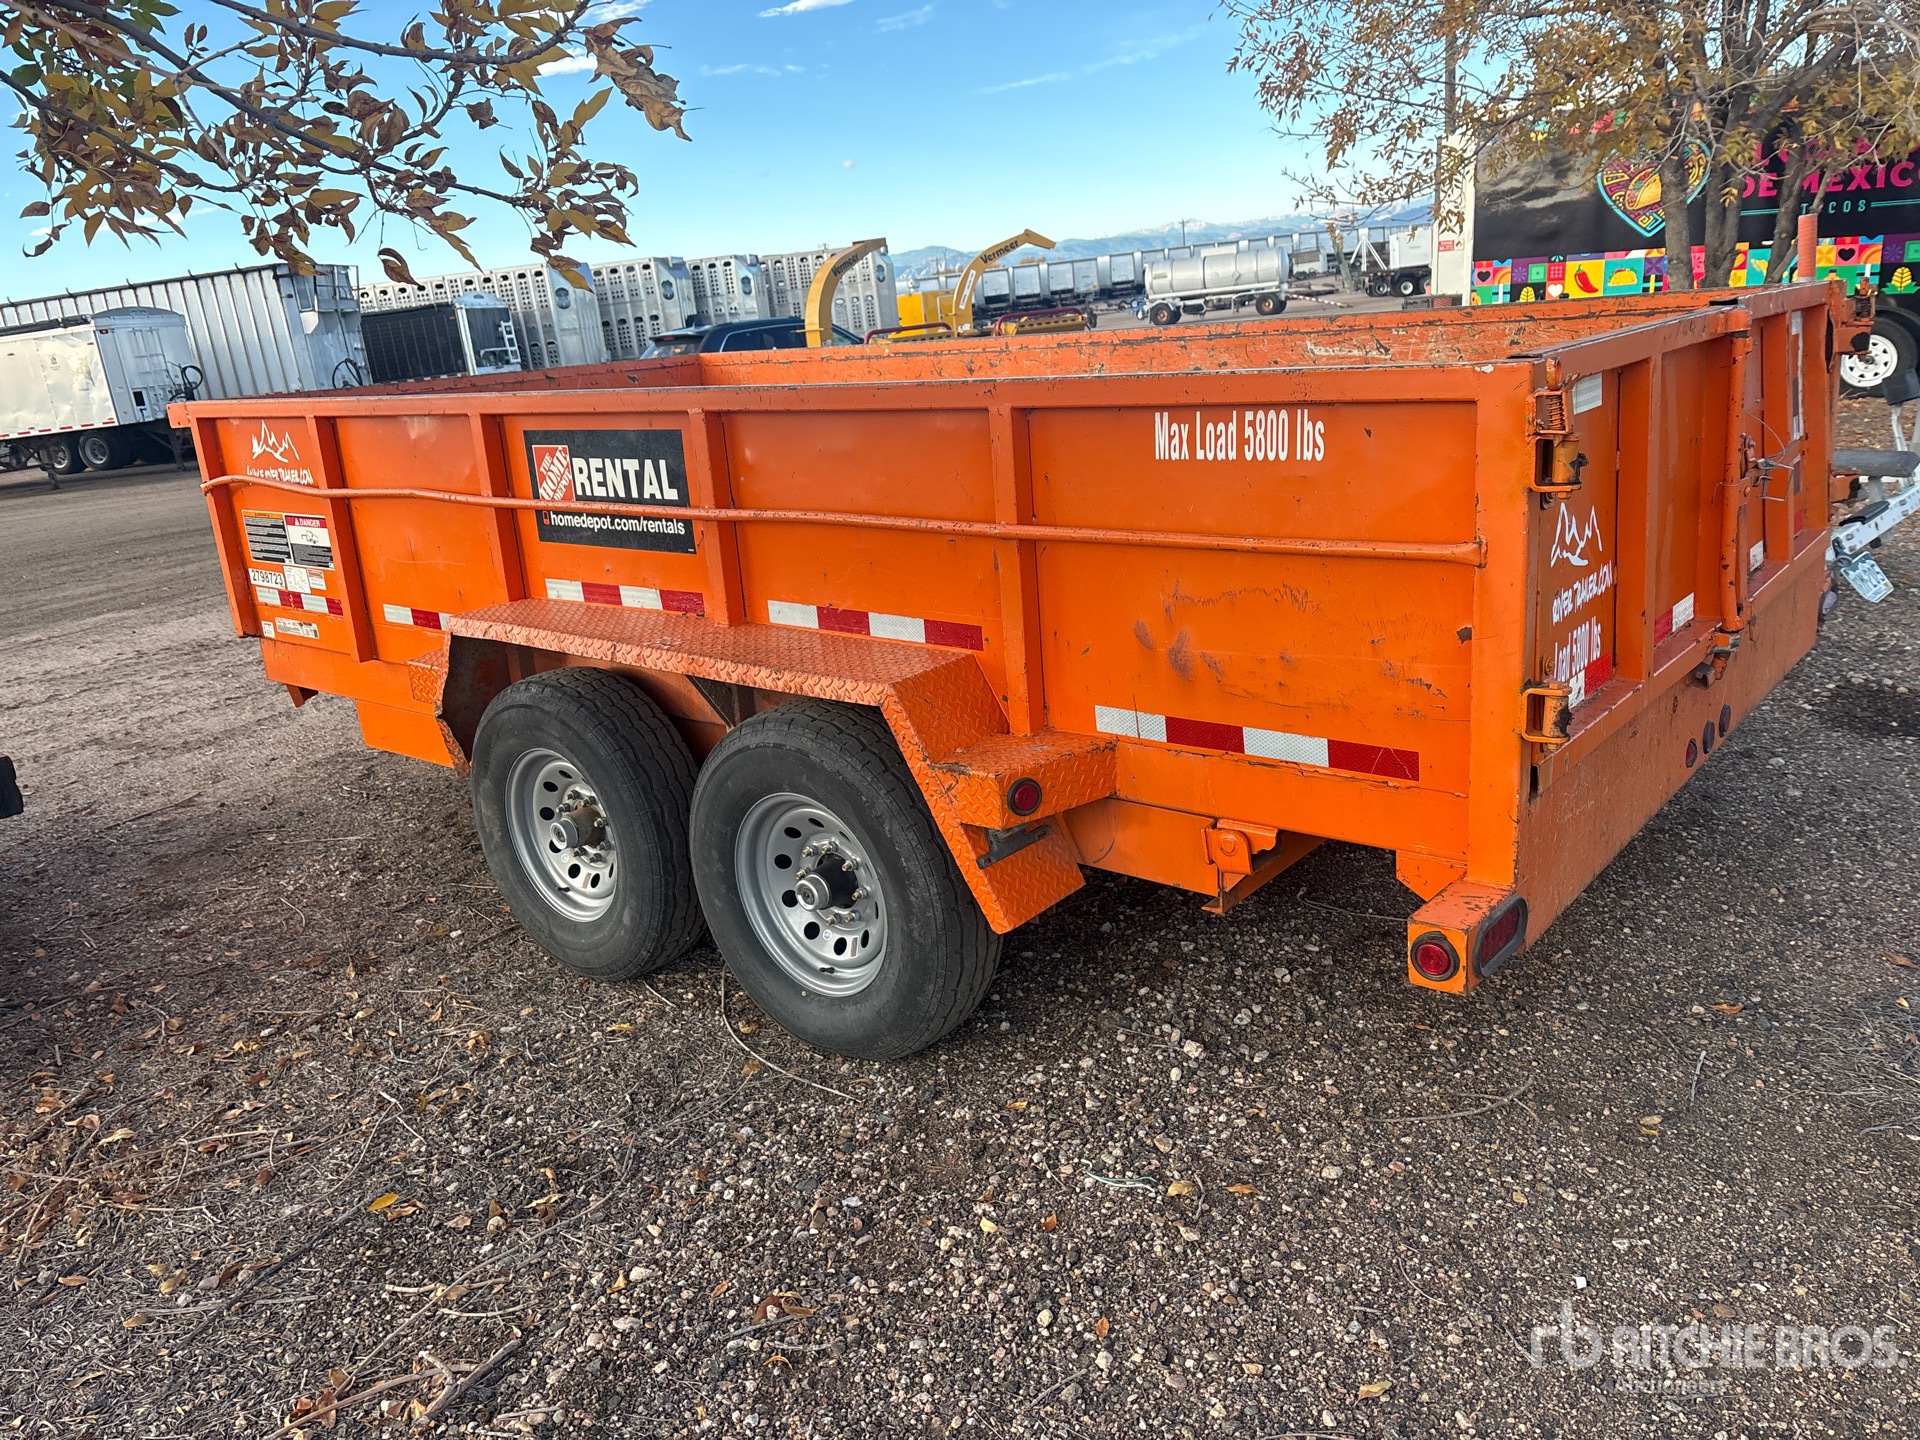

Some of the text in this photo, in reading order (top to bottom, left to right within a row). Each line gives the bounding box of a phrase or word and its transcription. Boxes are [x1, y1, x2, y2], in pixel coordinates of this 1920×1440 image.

[1803, 161, 1920, 194] MEXIC
[1800, 199, 1866, 215] TCOS
[980, 239, 1019, 264] Vermeer
[831, 252, 859, 277] Vermeer
[1154, 408, 1325, 462] Max Load 5800 lbs
[540, 452, 553, 476] THE
[540, 446, 570, 501] HOME
[553, 467, 572, 501] DEPOT
[571, 457, 679, 500] RENTAL
[299, 518, 321, 528] DANGER
[550, 511, 685, 535] homedepot.com/rentals
[251, 569, 284, 586] 2798723
[1554, 632, 1571, 683] Load
[1591, 615, 1602, 663] lbs
